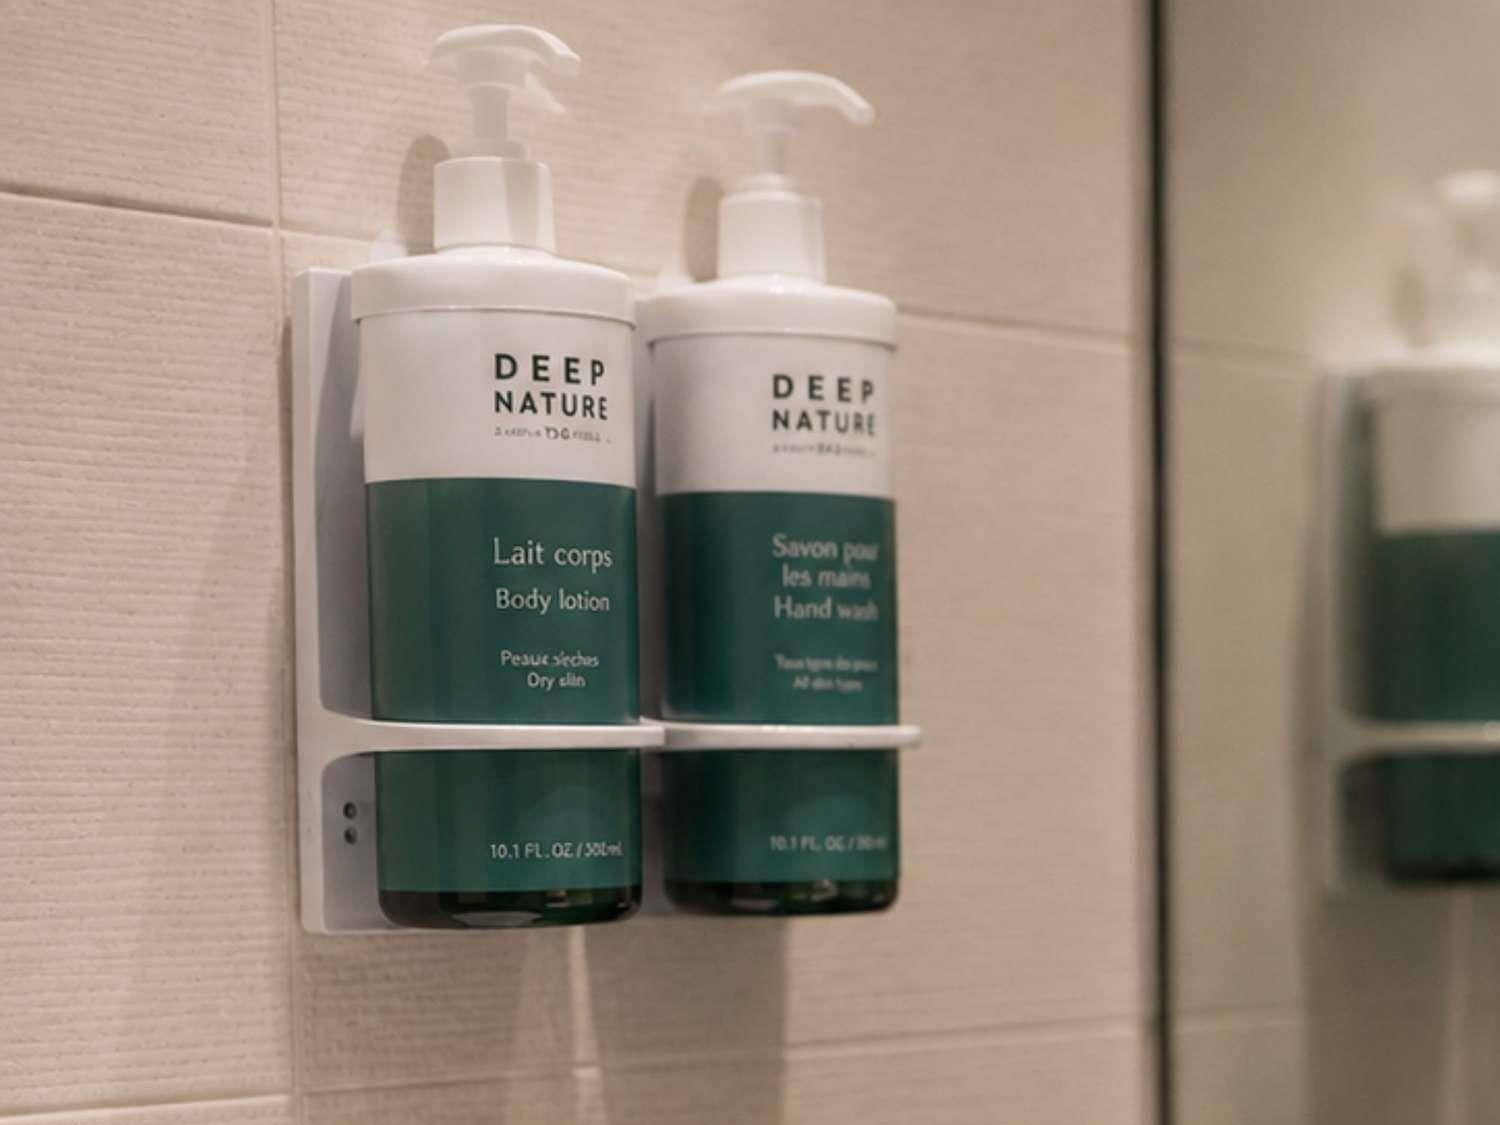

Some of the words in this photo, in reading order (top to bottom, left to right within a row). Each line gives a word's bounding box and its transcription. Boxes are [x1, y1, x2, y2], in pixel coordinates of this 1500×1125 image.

[494, 352, 606, 386] DEEP
[772, 373, 876, 404] DEEP
[494, 390, 609, 421] NATURE
[493, 536, 545, 566] Lait
[553, 547, 614, 575] corps
[772, 532, 838, 558] Savon
[782, 562, 813, 587] les
[495, 586, 552, 615] Body
[558, 587, 611, 612] lotion
[773, 595, 833, 619] Hand
[527, 671, 555, 692] Dry
[489, 843, 521, 860] 10.1
